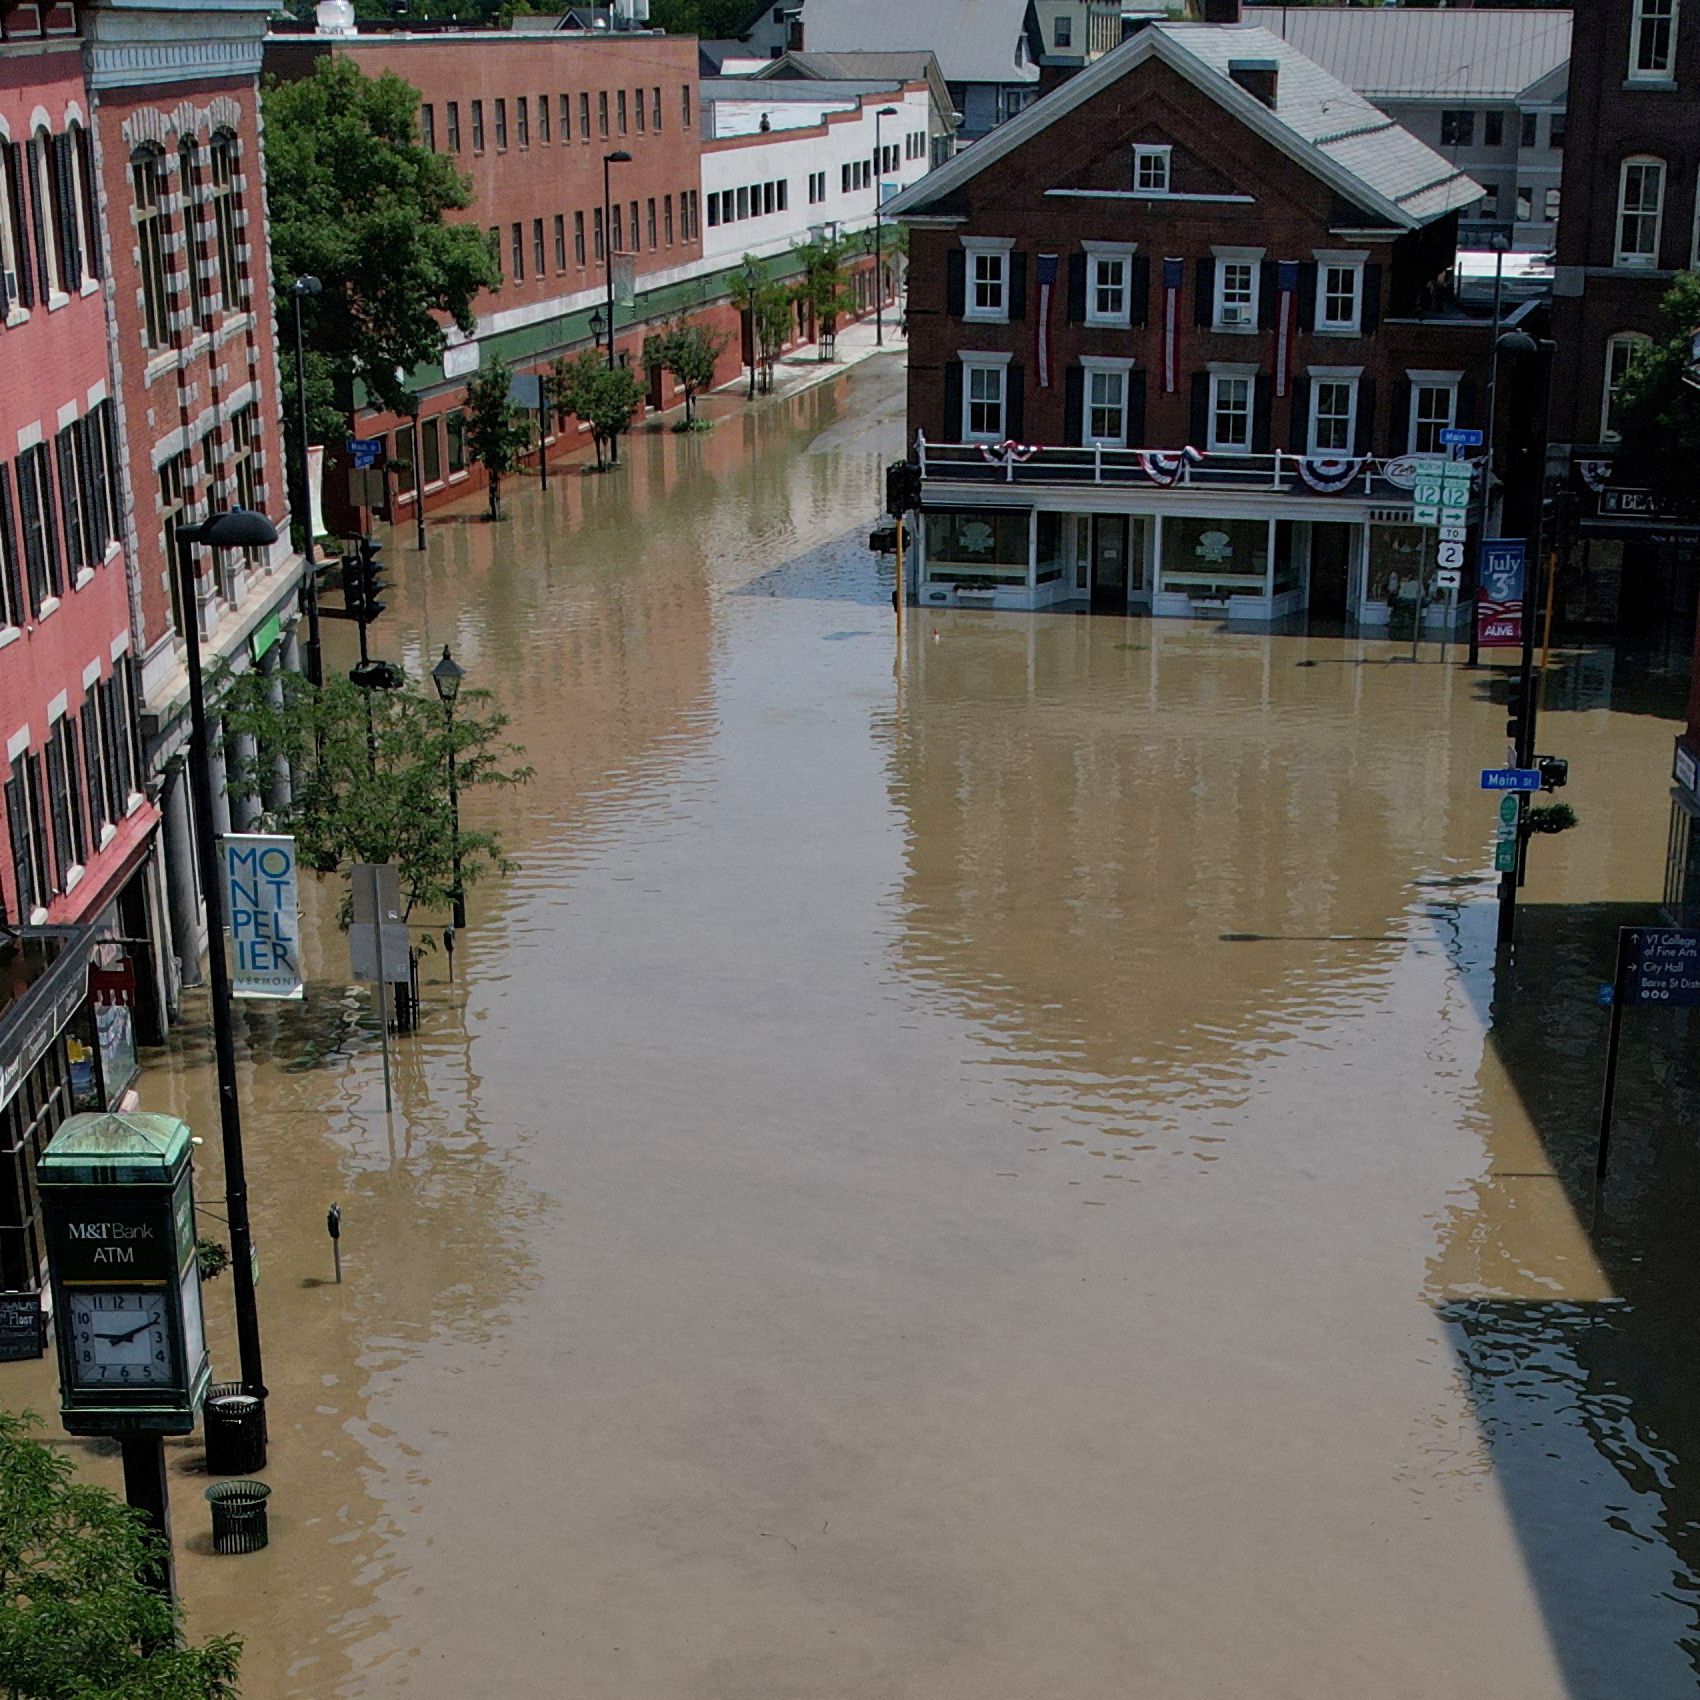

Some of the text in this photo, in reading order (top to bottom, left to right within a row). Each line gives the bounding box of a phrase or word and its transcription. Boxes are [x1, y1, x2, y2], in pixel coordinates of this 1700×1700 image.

[1420, 486, 1436, 503] 12
[1448, 488, 1464, 506] 12
[1447, 529, 1459, 538] TO
[1444, 547, 1457, 563] 2
[1484, 554, 1521, 577] July
[1484, 626, 1514, 637] ALIVE
[1488, 774, 1532, 786] Main St
[232, 909, 293, 942] PEL
[1645, 933, 1697, 947] VT College
[238, 940, 295, 971] IER
[1643, 946, 1698, 958] of Fine Arts
[1642, 961, 1684, 975] City Hall
[237, 976, 298, 986] VERMONT
[1641, 978, 1667, 988] Barre
[1669, 978, 1679, 989] St
[68, 1222, 155, 1239] M&T Bank
[93, 1246, 134, 1263] ATM
[92, 1296, 103, 1310] 11
[113, 1296, 124, 1310] 12
[138, 1297, 143, 1309] 1
[77, 1312, 90, 1325] 10
[153, 1312, 161, 1325] 2
[81, 1331, 90, 1343] 9
[155, 1332, 163, 1344] 3
[83, 1350, 92, 1362] 8
[155, 1350, 165, 1362] 4
[99, 1366, 107, 1378] 7
[120, 1366, 129, 1378] 6
[143, 1365, 152, 1377] 5
